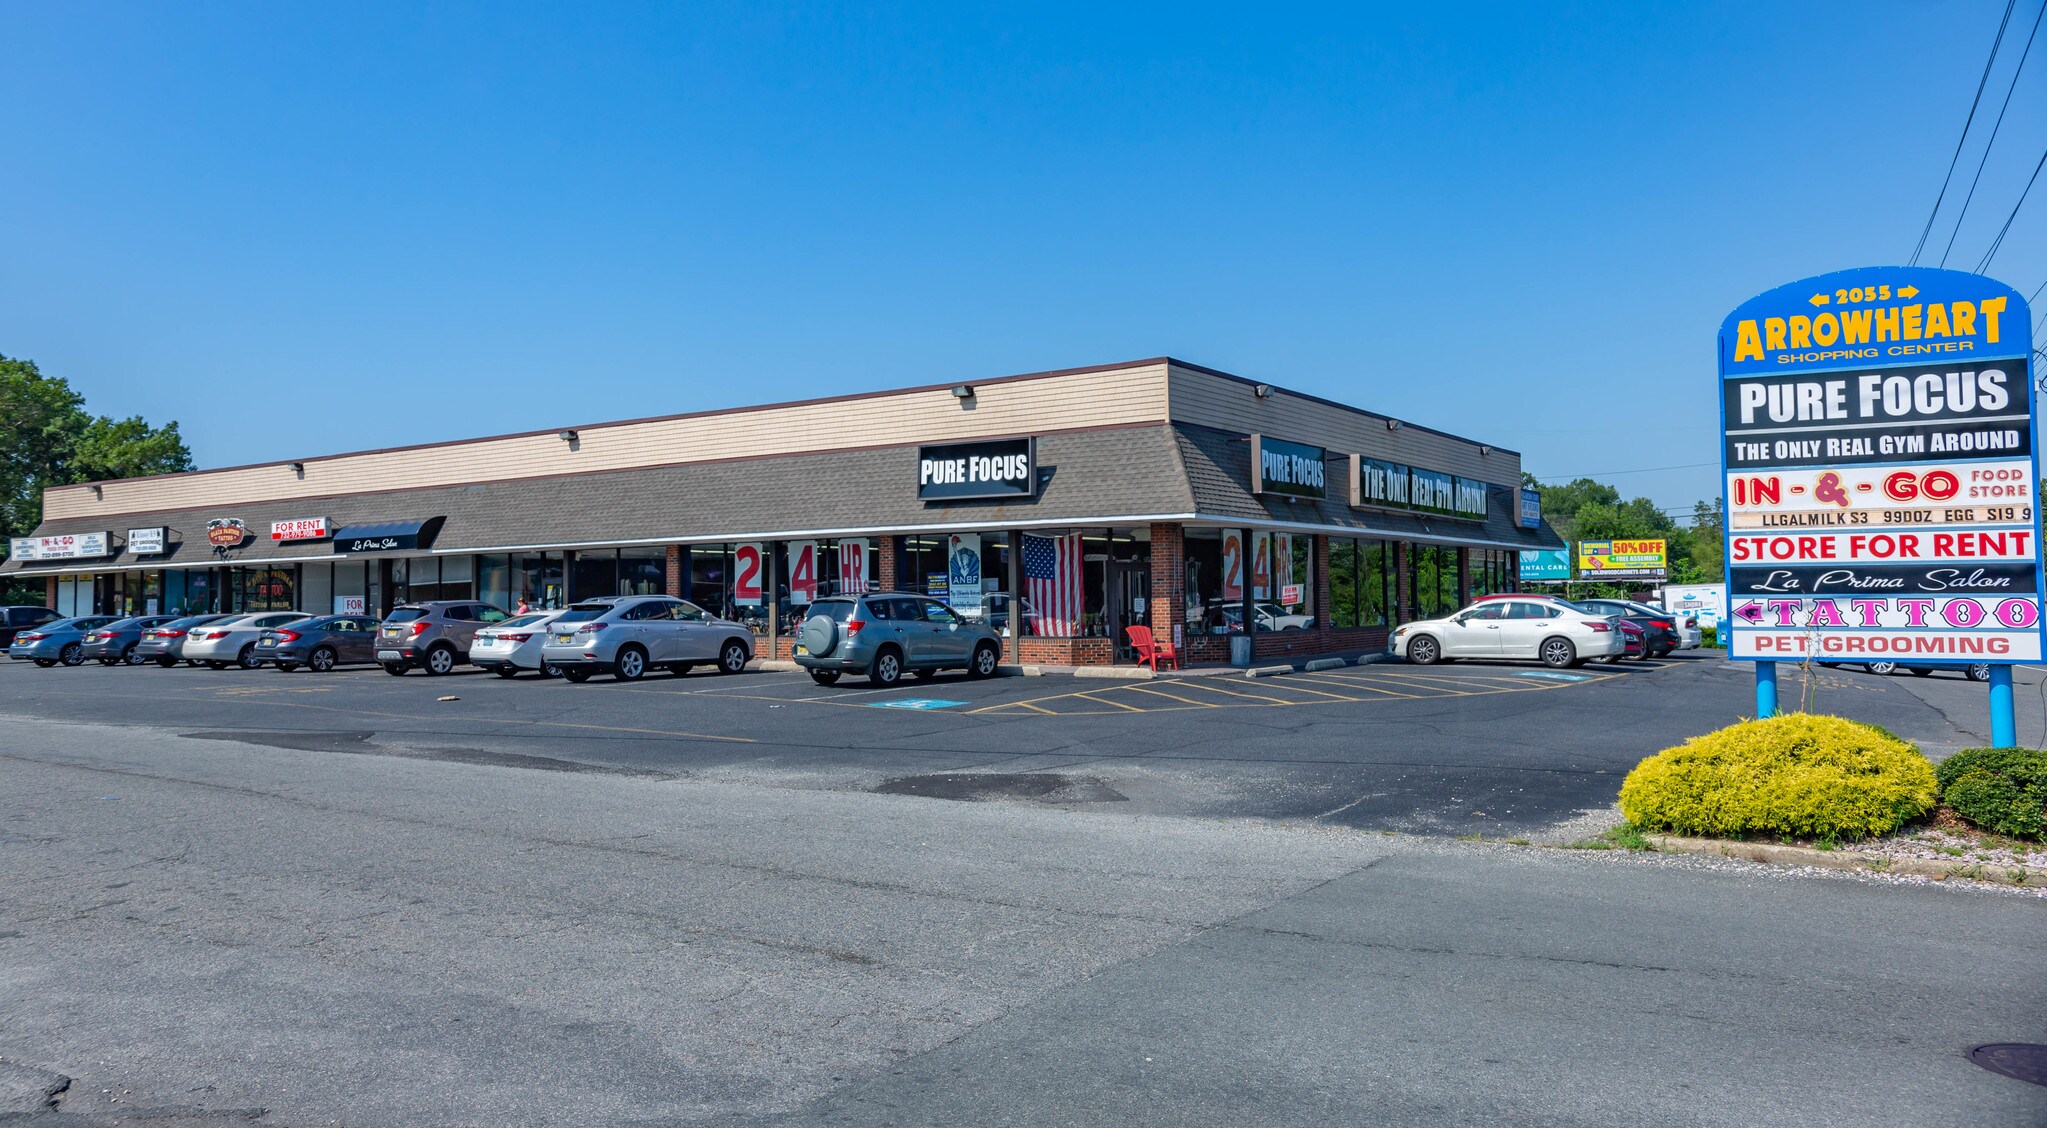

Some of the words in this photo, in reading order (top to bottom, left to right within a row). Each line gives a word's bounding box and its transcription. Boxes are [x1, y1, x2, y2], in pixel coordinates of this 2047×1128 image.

[1836, 285, 1892, 305] 2055
[1734, 296, 2007, 362] ARROWHEART
[1777, 348, 1878, 364] SHOPPING
[1888, 341, 1974, 356] CENTER
[1740, 380, 1848, 424] PURE
[1858, 369, 2009, 417] FOCUS
[1735, 442, 1770, 461] THE
[1775, 439, 1821, 458] ONLY
[1827, 437, 1874, 457] REAL
[1880, 434, 1924, 456] GYM
[1930, 430, 2019, 452] AROUND
[921, 459, 966, 484] PURE
[970, 454, 1028, 482] FOCUS
[1262, 449, 1290, 483] PURE
[1292, 456, 1324, 488] FOCUS
[1971, 469, 2023, 482] FOOD
[1363, 465, 1384, 500] THE
[1386, 468, 1408, 503] ONLY
[1412, 474, 1434, 506] REAL
[1436, 478, 1452, 510] GYM
[1456, 483, 1486, 514] AROUND
[1969, 484, 2028, 498] STORE
[276, 522, 294, 532] FOR
[296, 520, 320, 530] RENT
[1945, 509, 1974, 522] EGG
[1614, 542, 1637, 554] 50%
[1638, 542, 1662, 553] OFF
[1733, 536, 1836, 560] STORE
[1850, 534, 1920, 558] FOR
[1934, 532, 2030, 557] RENT
[736, 546, 760, 598] 2
[792, 545, 816, 601] 4
[1224, 536, 1241, 598] 2
[1254, 537, 1269, 598] 4
[260, 584, 282, 596] TATOO
[1750, 570, 1800, 592] La
[1813, 570, 1904, 592] Prima
[1918, 568, 2010, 591] Salon
[346, 600, 363, 610] FOR
[1767, 598, 2040, 628] TATTOO
[1755, 636, 1809, 652] PET
[1822, 636, 2010, 654] GROOMING
